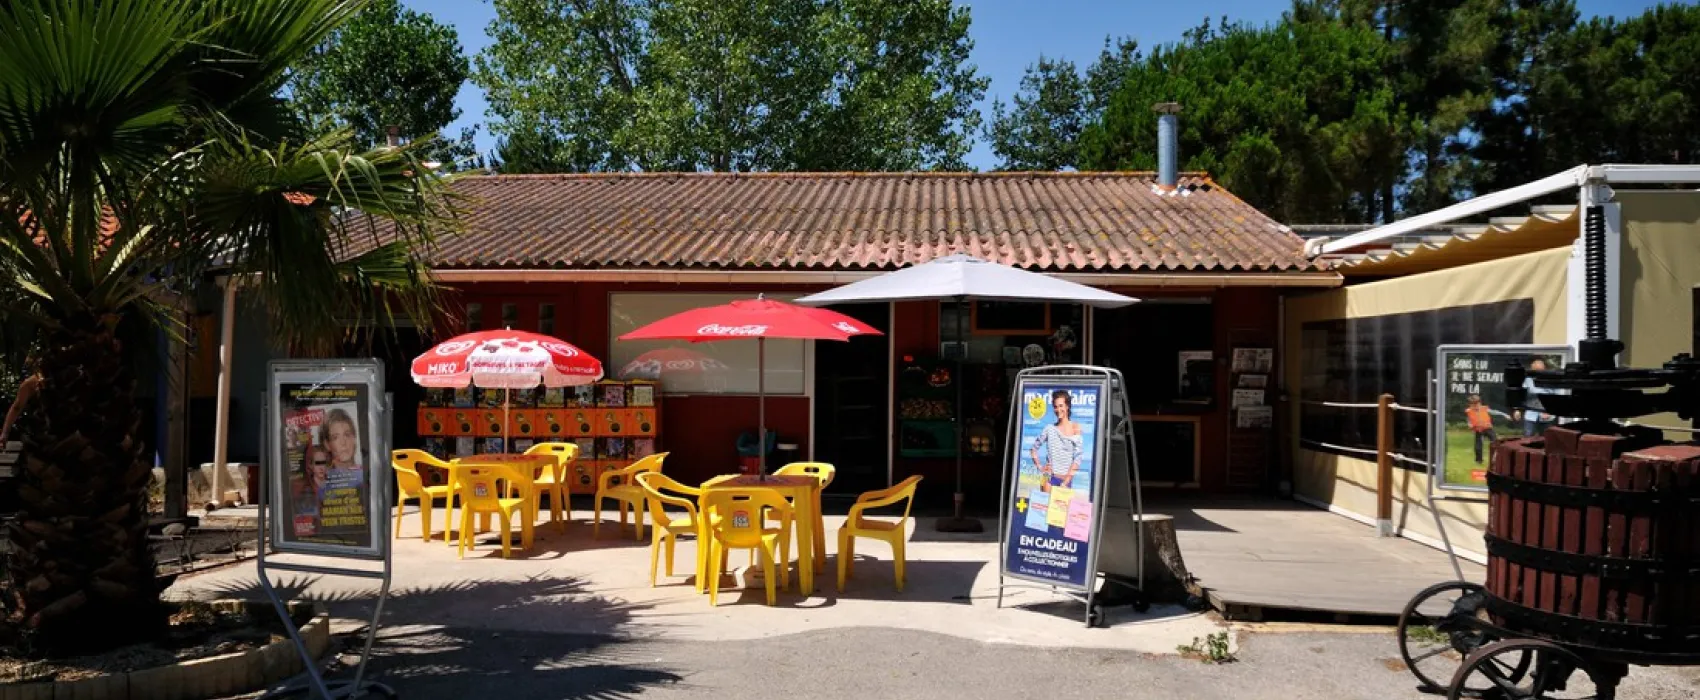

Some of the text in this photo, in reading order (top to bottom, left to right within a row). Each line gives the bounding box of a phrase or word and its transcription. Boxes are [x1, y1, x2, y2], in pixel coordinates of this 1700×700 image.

[427, 362, 457, 375] MIKO
[1453, 358, 1488, 370] SANS LUI
[1461, 371, 1473, 381] NE
[1476, 371, 1505, 383] SERAIT
[1450, 383, 1466, 393] PAS
[1020, 534, 1078, 553] EN CADEAU
